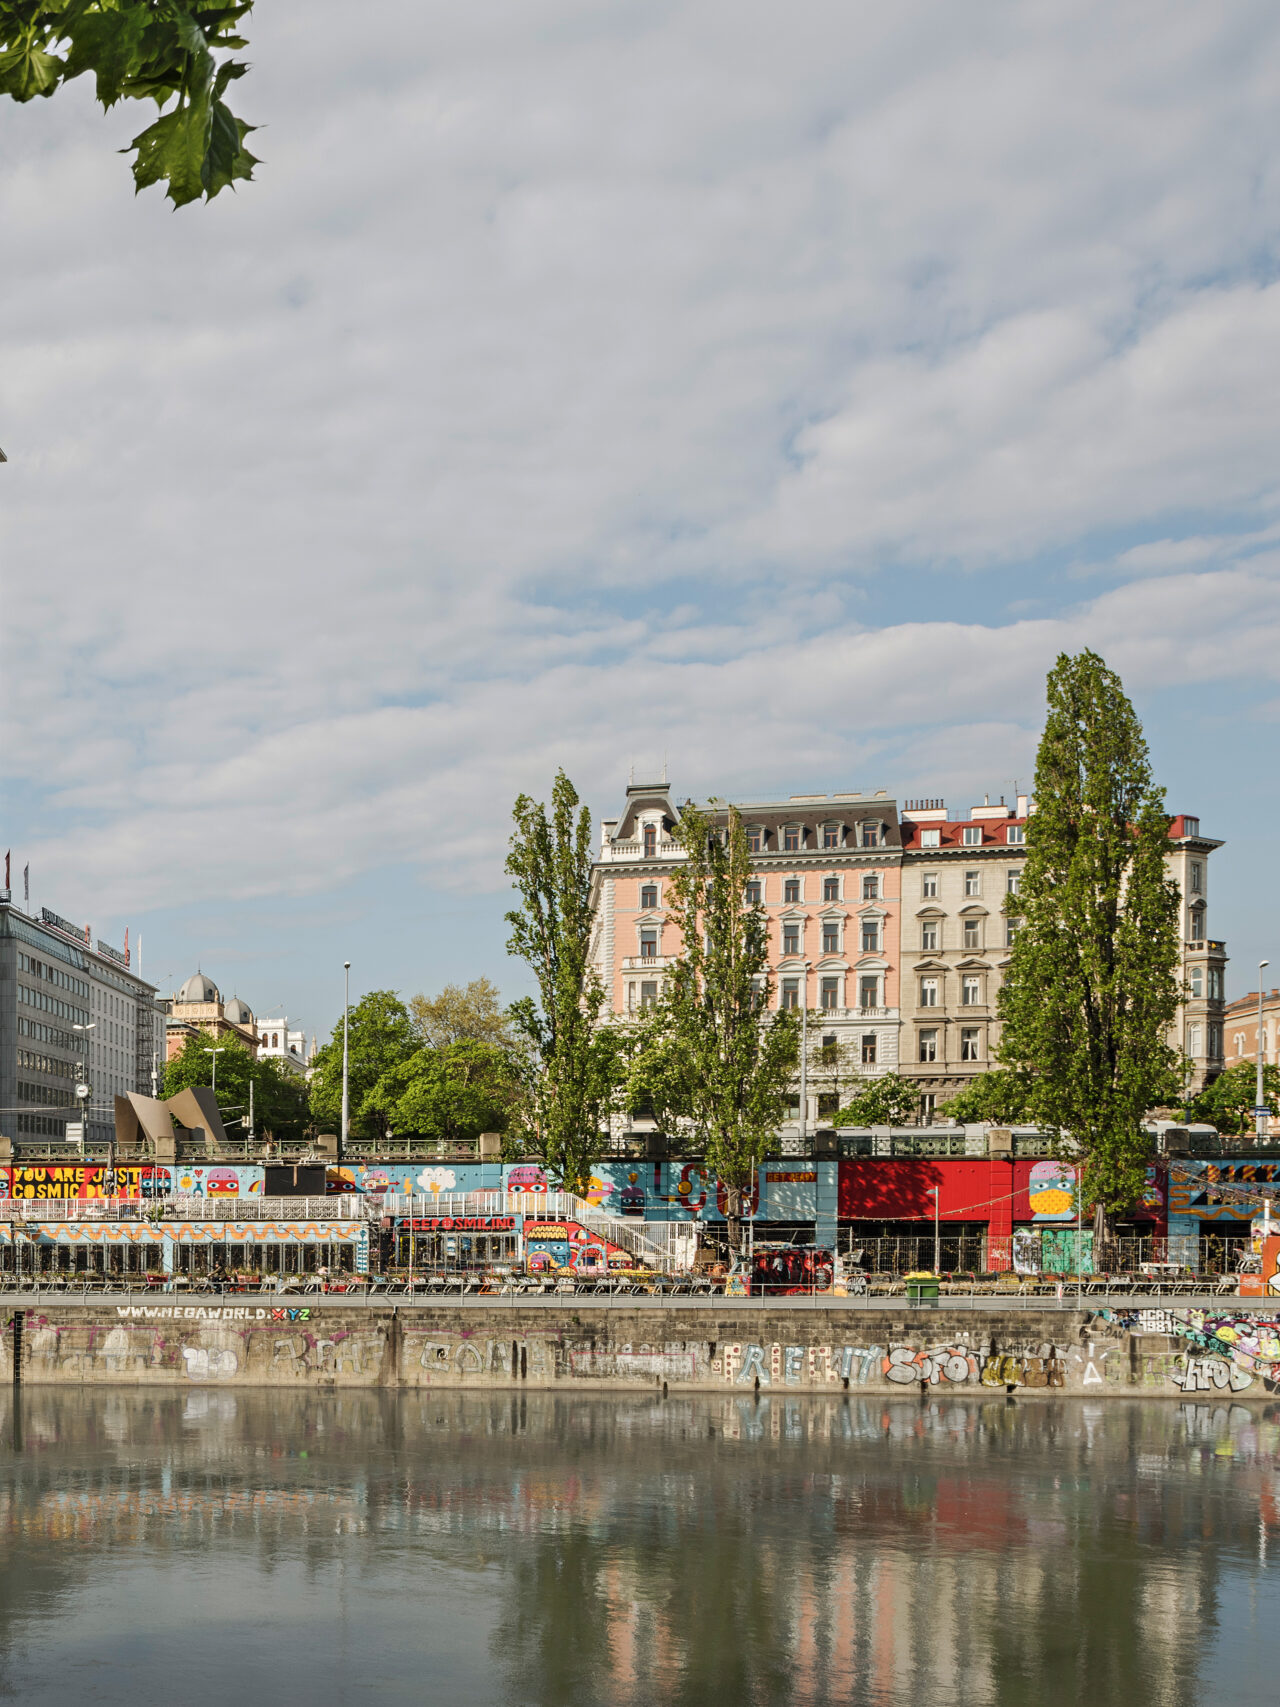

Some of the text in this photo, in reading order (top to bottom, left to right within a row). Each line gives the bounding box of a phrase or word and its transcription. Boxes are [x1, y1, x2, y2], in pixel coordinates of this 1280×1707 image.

[13, 1167, 47, 1182] YOU
[52, 1168, 85, 1183] ARE
[767, 1173, 786, 1182] GET
[12, 1184, 80, 1199] COSMIC
[403, 1216, 516, 1231] KEEP SMILING
[117, 1306, 311, 1321] WWW.MEGAWORLD.XYZ
